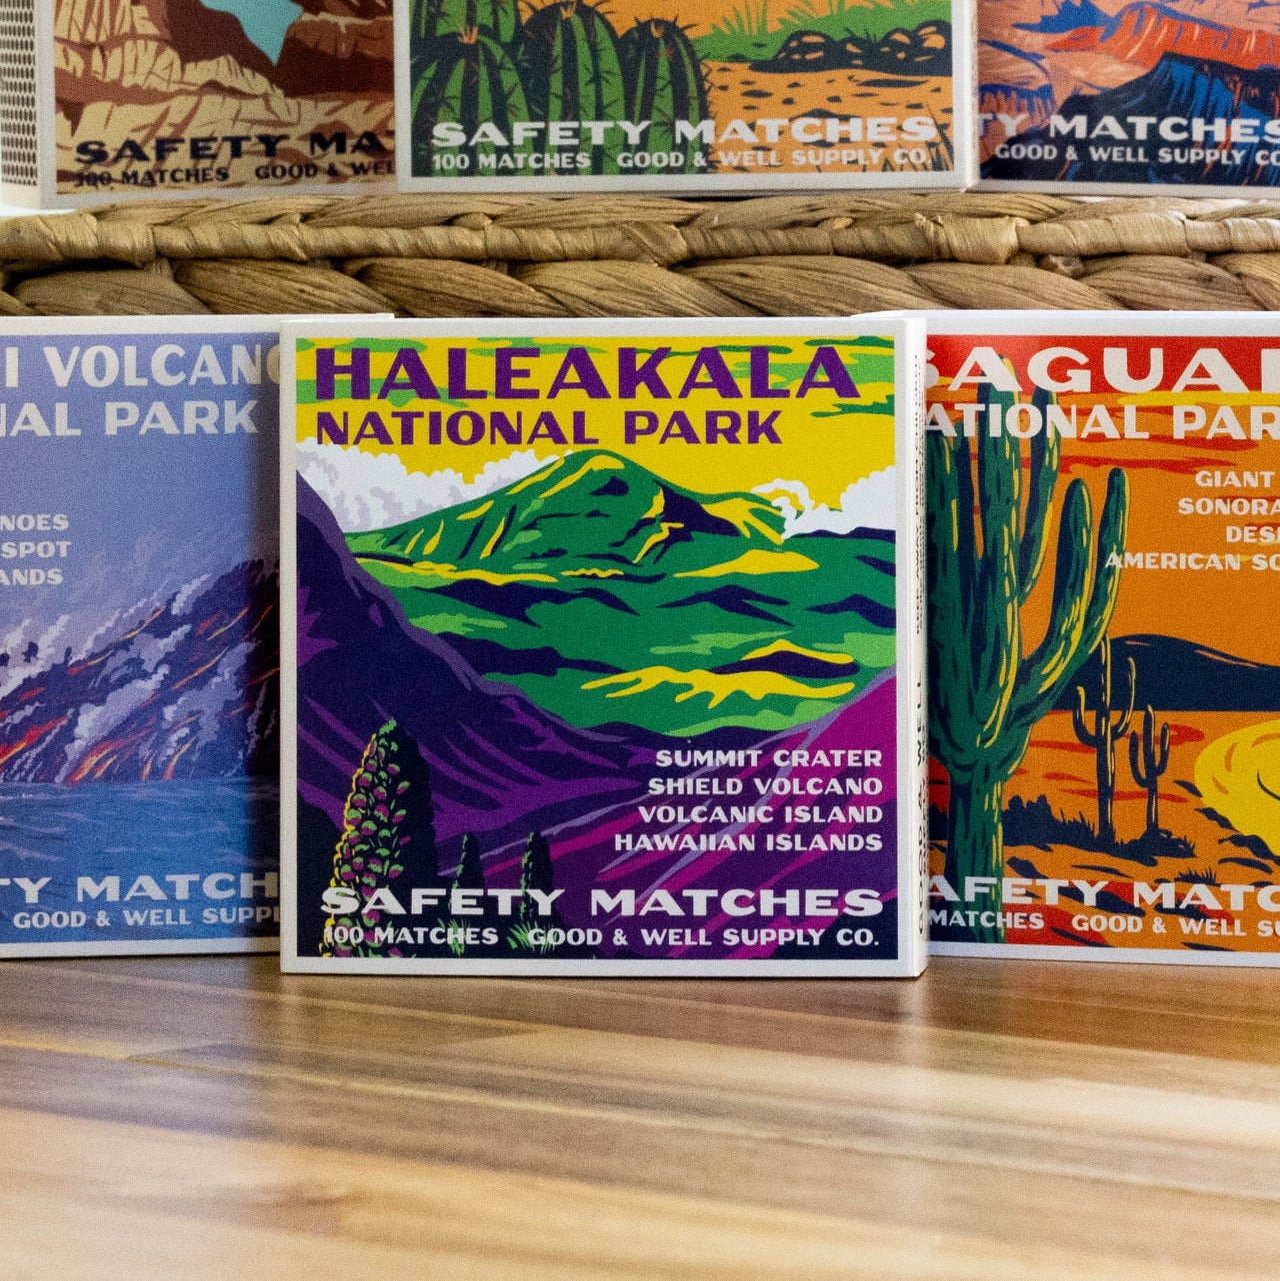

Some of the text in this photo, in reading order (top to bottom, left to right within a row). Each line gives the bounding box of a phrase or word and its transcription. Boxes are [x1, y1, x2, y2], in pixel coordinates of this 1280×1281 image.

[432, 117, 937, 148] SAFETY MATCHES
[75, 134, 291, 165] SAFETY
[432, 153, 469, 171] 100
[478, 152, 591, 170] MATCHES
[617, 151, 686, 168] GOOD
[720, 150, 781, 168] WELL
[792, 149, 882, 166] SUPPLY
[995, 144, 1057, 160] GOOD
[1089, 146, 1149, 163] WELL
[1158, 147, 1243, 165] SUPPLY
[122, 163, 319, 186] MATCHES GOOD
[316, 346, 862, 400] HALEAKALA
[104, 399, 259, 436] PARK
[317, 410, 783, 445] NATIONAL PARK
[925, 404, 1150, 440] ATIONAL
[1195, 471, 1273, 489] GIANT
[1104, 552, 1241, 570] AMERICAN
[656, 749, 883, 768] SUMMIT CRATER
[648, 777, 883, 796] SHIELD VOLCANO
[638, 805, 883, 824] VOLCANIC ISLAND
[614, 833, 883, 852] HAWAIIAN ISLANDS
[76, 872, 279, 902] MATCH
[929, 877, 1110, 907] AFETY
[320, 888, 884, 917] SAFETY MATCHES
[13, 912, 86, 929] GOOD
[96, 911, 110, 927] &
[122, 909, 191, 926] WELL
[929, 910, 1044, 930] MATCHES
[1072, 914, 1142, 934] GOOD
[1152, 916, 1167, 934] &
[1179, 917, 1246, 937] WELL
[324, 927, 364, 946] 100
[374, 927, 498, 946] MATCHES
[527, 927, 603, 947] GOOD
[613, 928, 629, 947] &
[641, 928, 714, 946] WELL
[723, 928, 825, 947] SUPPLY
